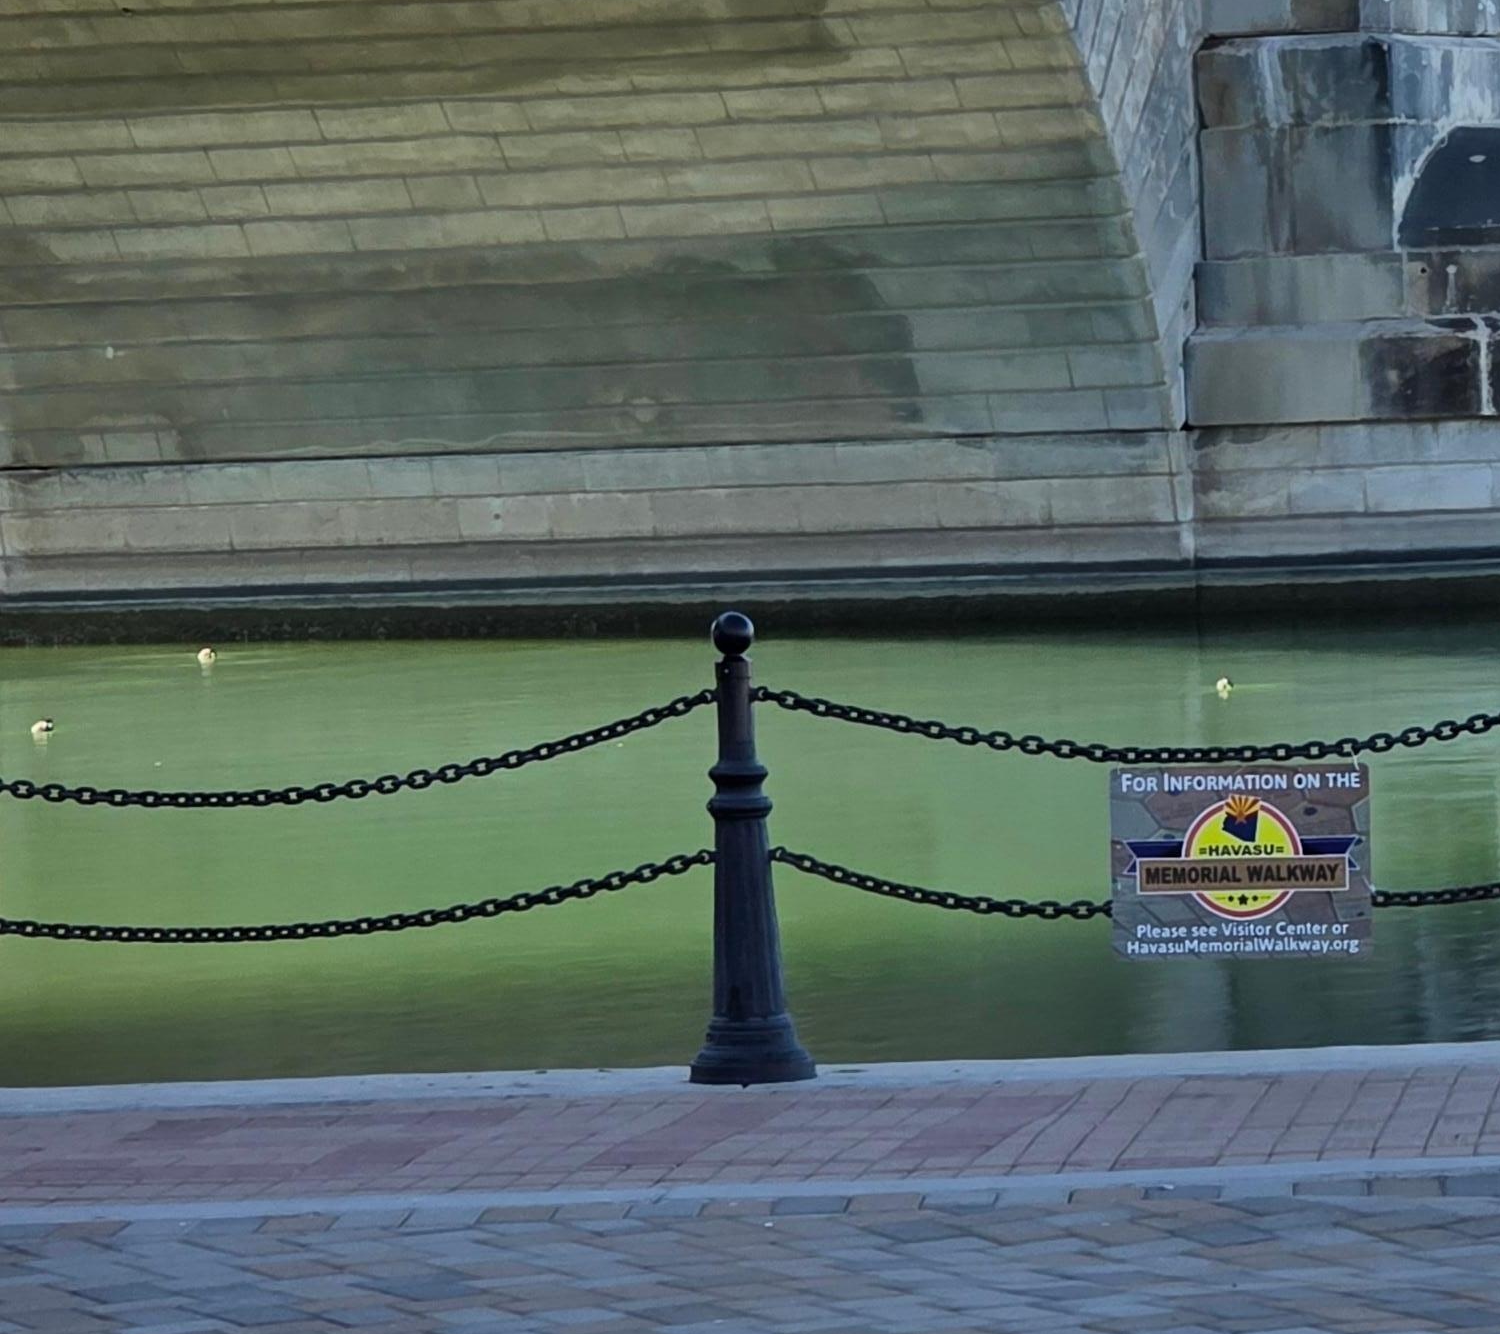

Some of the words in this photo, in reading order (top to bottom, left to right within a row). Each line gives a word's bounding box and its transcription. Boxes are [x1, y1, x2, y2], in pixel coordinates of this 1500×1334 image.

[1293, 774, 1320, 788] ON
[1325, 772, 1361, 788] THE
[1208, 844, 1275, 857] HAVASU
[1145, 866, 1241, 885] MEMORIAL
[1247, 863, 1339, 883] WALKWAY
[1137, 924, 1187, 938] Please
[1191, 926, 1217, 937] see
[1221, 923, 1271, 937] Visitor
[1276, 921, 1328, 935] Center
[1332, 924, 1349, 934] or
[1127, 938, 1360, 954] HavasuMemorialWalkway.org
